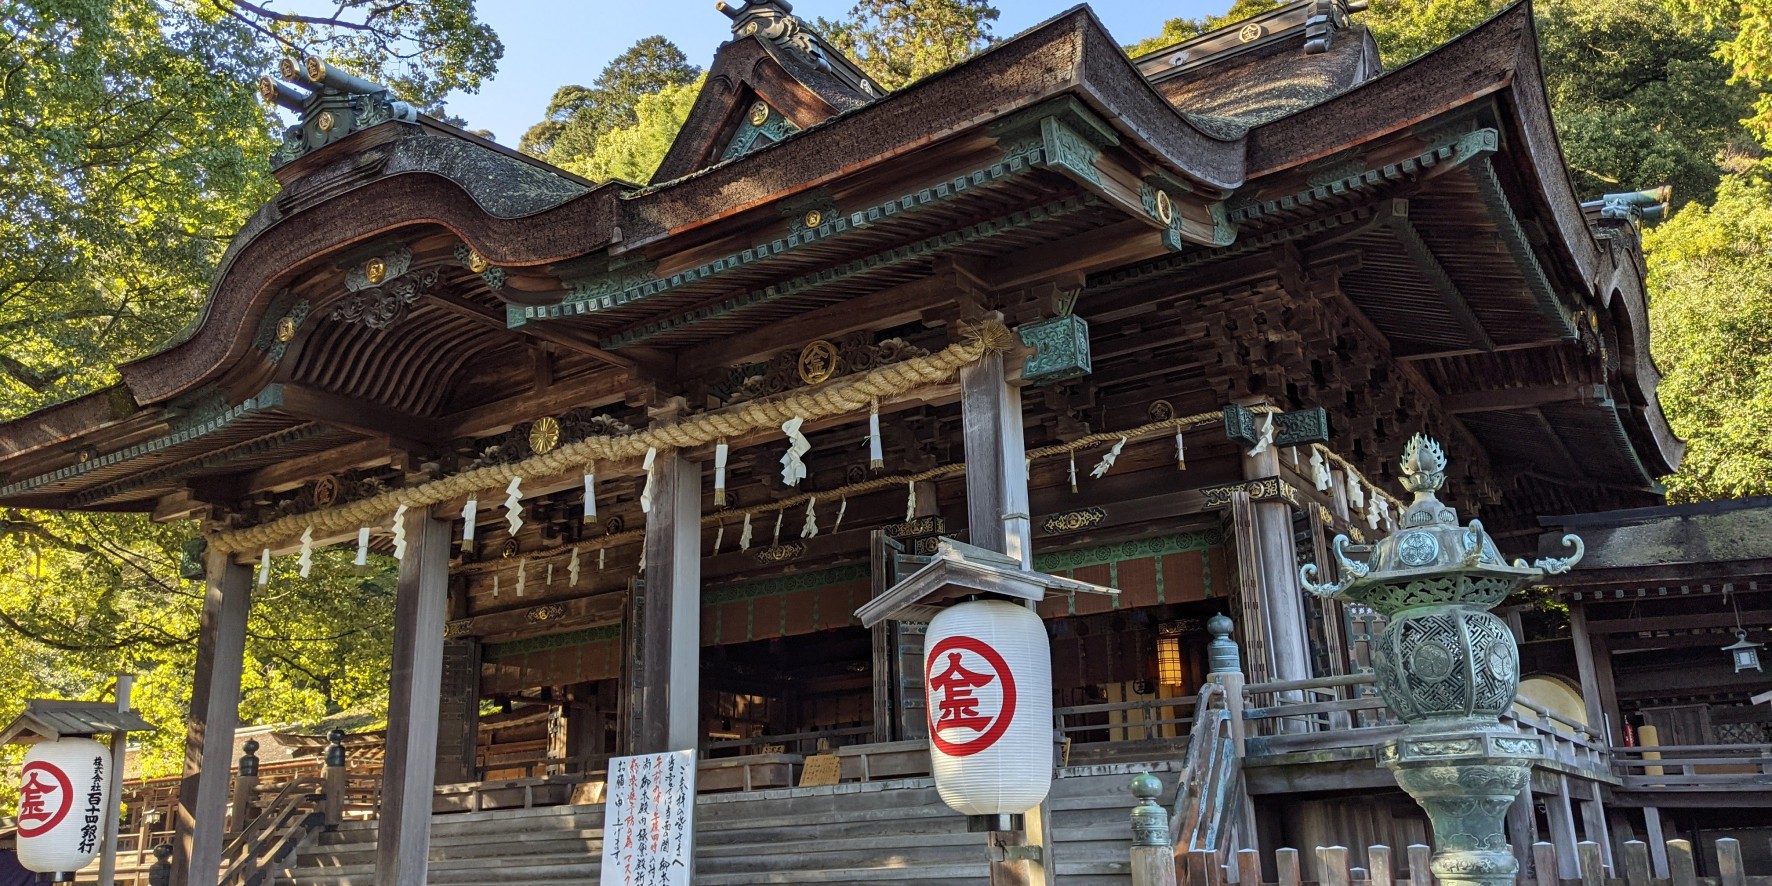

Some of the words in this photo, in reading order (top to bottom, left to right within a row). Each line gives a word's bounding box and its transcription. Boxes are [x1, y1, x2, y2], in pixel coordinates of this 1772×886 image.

[77, 755, 104, 854] 株式会社百十四銀行
